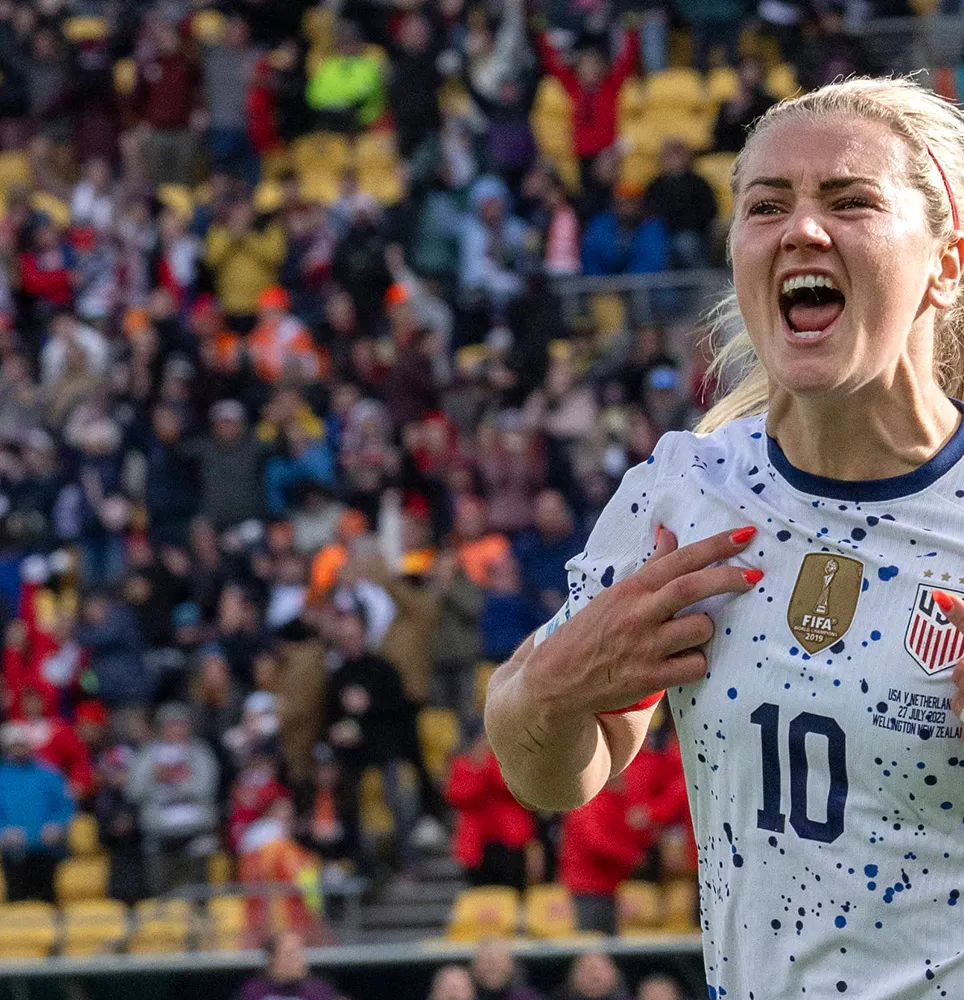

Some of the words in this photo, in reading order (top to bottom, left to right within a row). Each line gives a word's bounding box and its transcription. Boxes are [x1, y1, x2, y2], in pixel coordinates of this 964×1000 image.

[802, 614, 832, 631] FIFA
[804, 632, 824, 643] 2019
[810, 628, 838, 638] CHAMPIONS
[888, 688, 902, 702] USA
[904, 691, 910, 704] V
[910, 693, 952, 710] NETHERLAN
[898, 705, 908, 718] 27
[909, 708, 926, 721] JULY
[926, 710, 946, 724] 2023
[872, 713, 916, 736] WELLINGTON
[936, 725, 963, 739] ZEALA
[750, 702, 849, 844] 10
